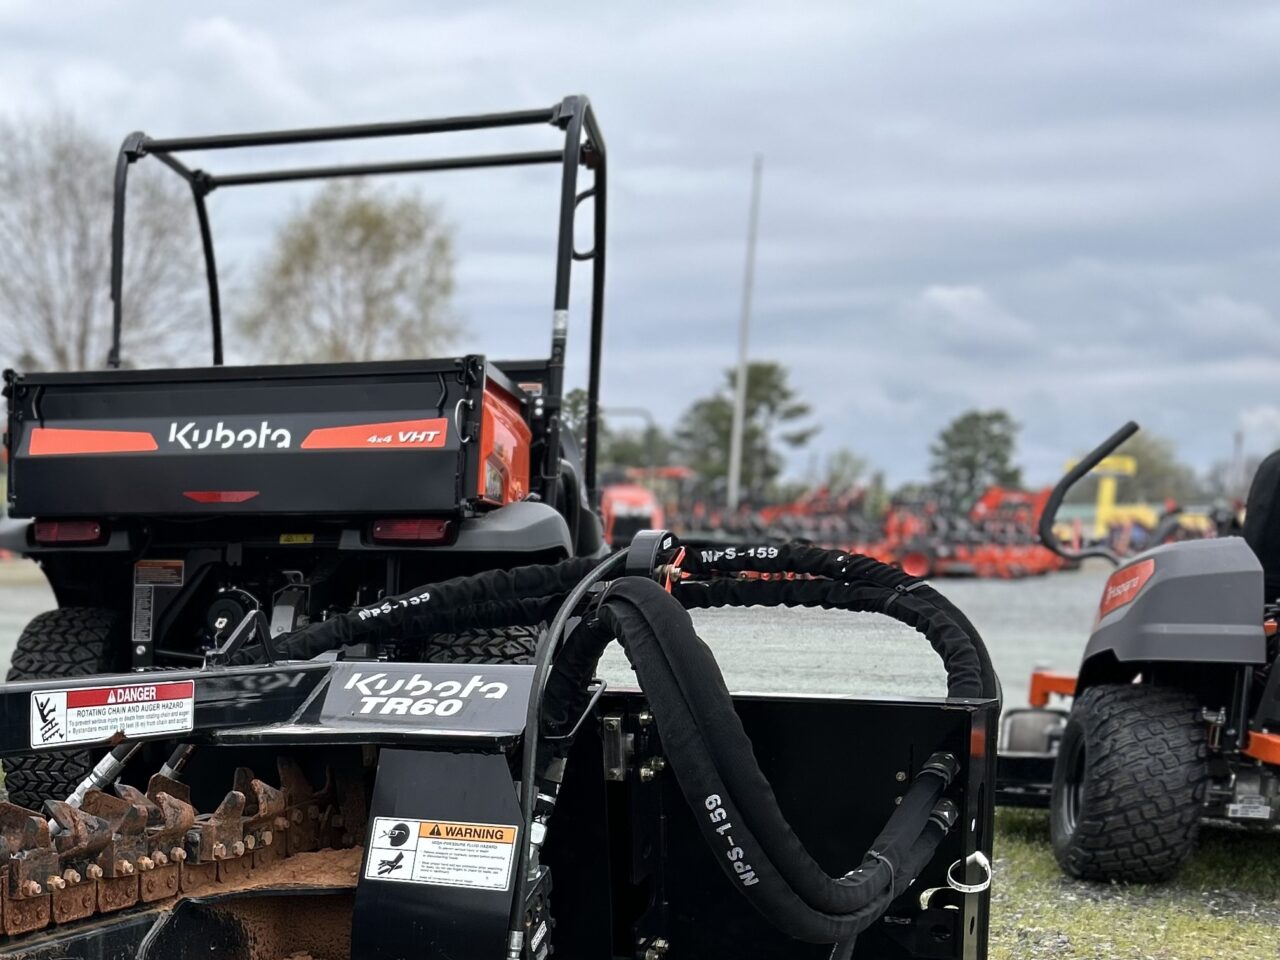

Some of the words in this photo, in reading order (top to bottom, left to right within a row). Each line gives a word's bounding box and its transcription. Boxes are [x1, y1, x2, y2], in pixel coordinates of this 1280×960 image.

[169, 421, 292, 450] Kubota
[367, 434, 393, 444] 4x4
[398, 431, 441, 443] VHT
[701, 546, 779, 563] NPS-159
[344, 673, 508, 699] Kubota
[117, 687, 157, 703] DANGER
[76, 708, 106, 718] ROTATING
[108, 706, 126, 715] CHAIN
[128, 705, 140, 713] AND
[141, 703, 160, 712] AUGER
[162, 701, 184, 710] HAZARD
[360, 696, 464, 717] TR60
[445, 826, 504, 840] WARNING
[705, 794, 760, 886] NPS-159
